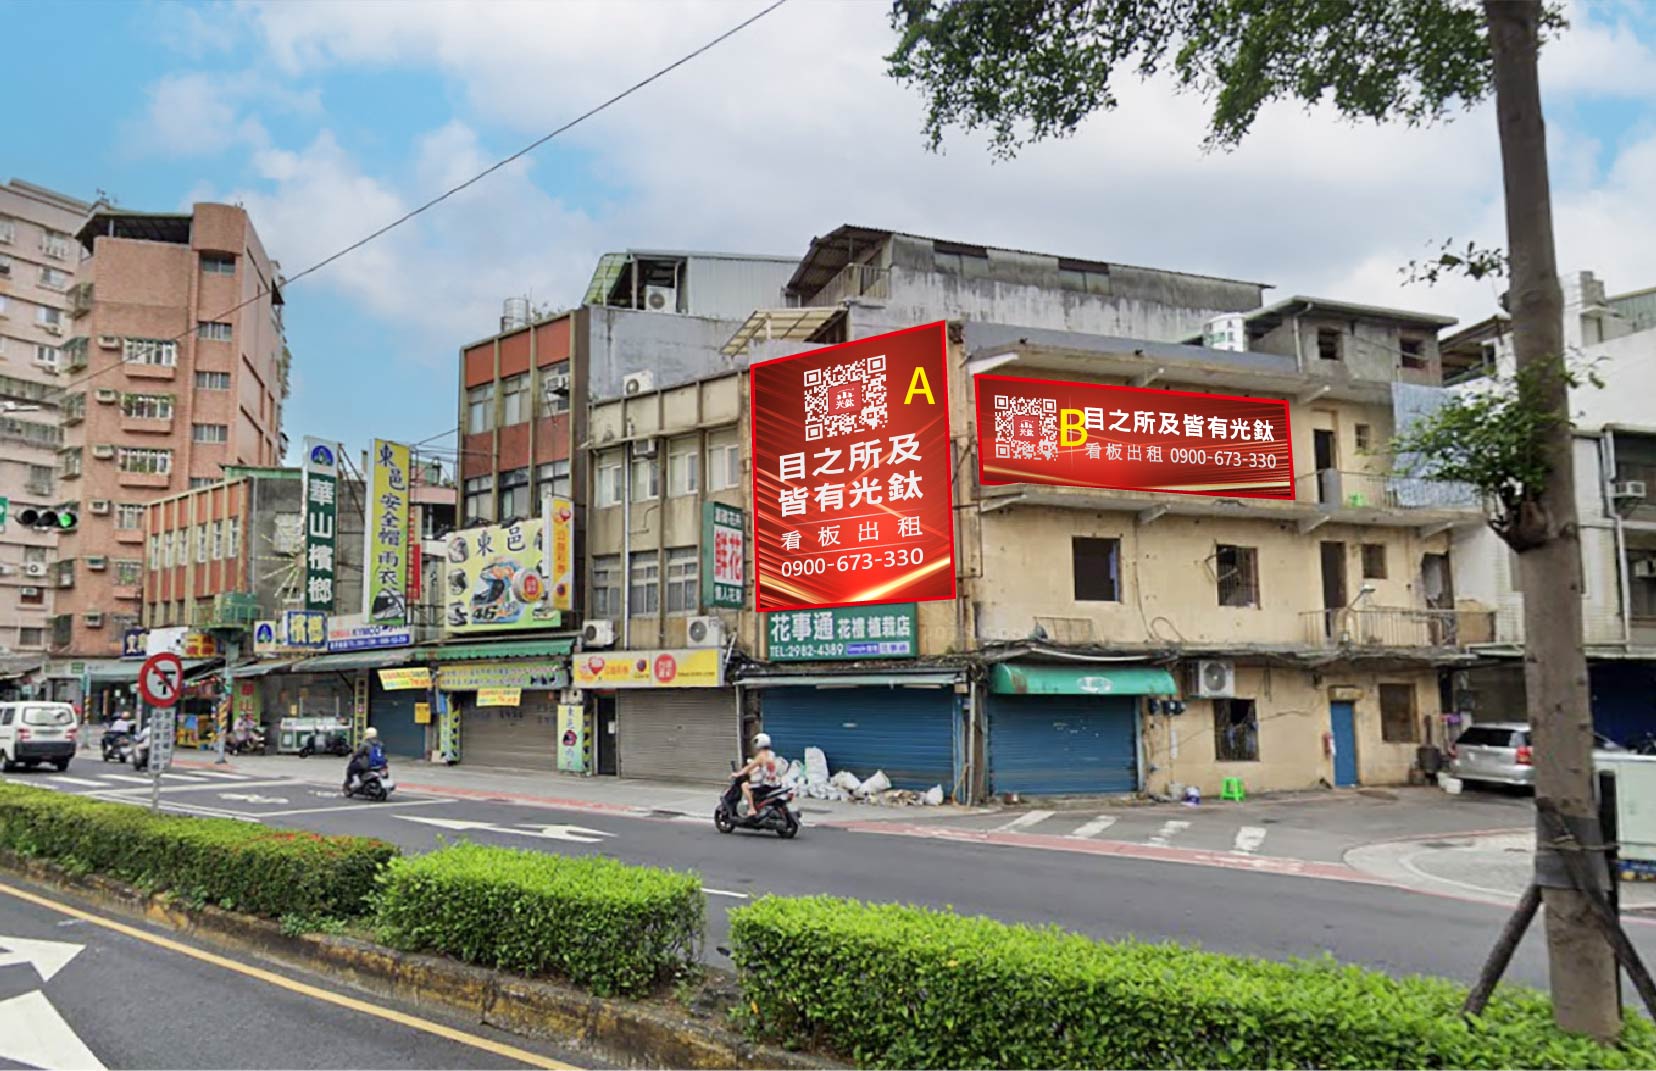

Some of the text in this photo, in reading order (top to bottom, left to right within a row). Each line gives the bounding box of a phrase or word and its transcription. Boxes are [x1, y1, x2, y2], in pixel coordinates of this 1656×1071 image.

[1084, 406, 1275, 442] 目之所及皆有光鈦
[778, 433, 923, 483] 目之所及
[1085, 443, 1277, 469] 看板出租 0900-673-330
[778, 469, 924, 518] 皆有光鈦
[780, 516, 923, 551] 看板出租
[780, 548, 924, 578] 0900-673-330
[770, 612, 834, 642] 花事通
